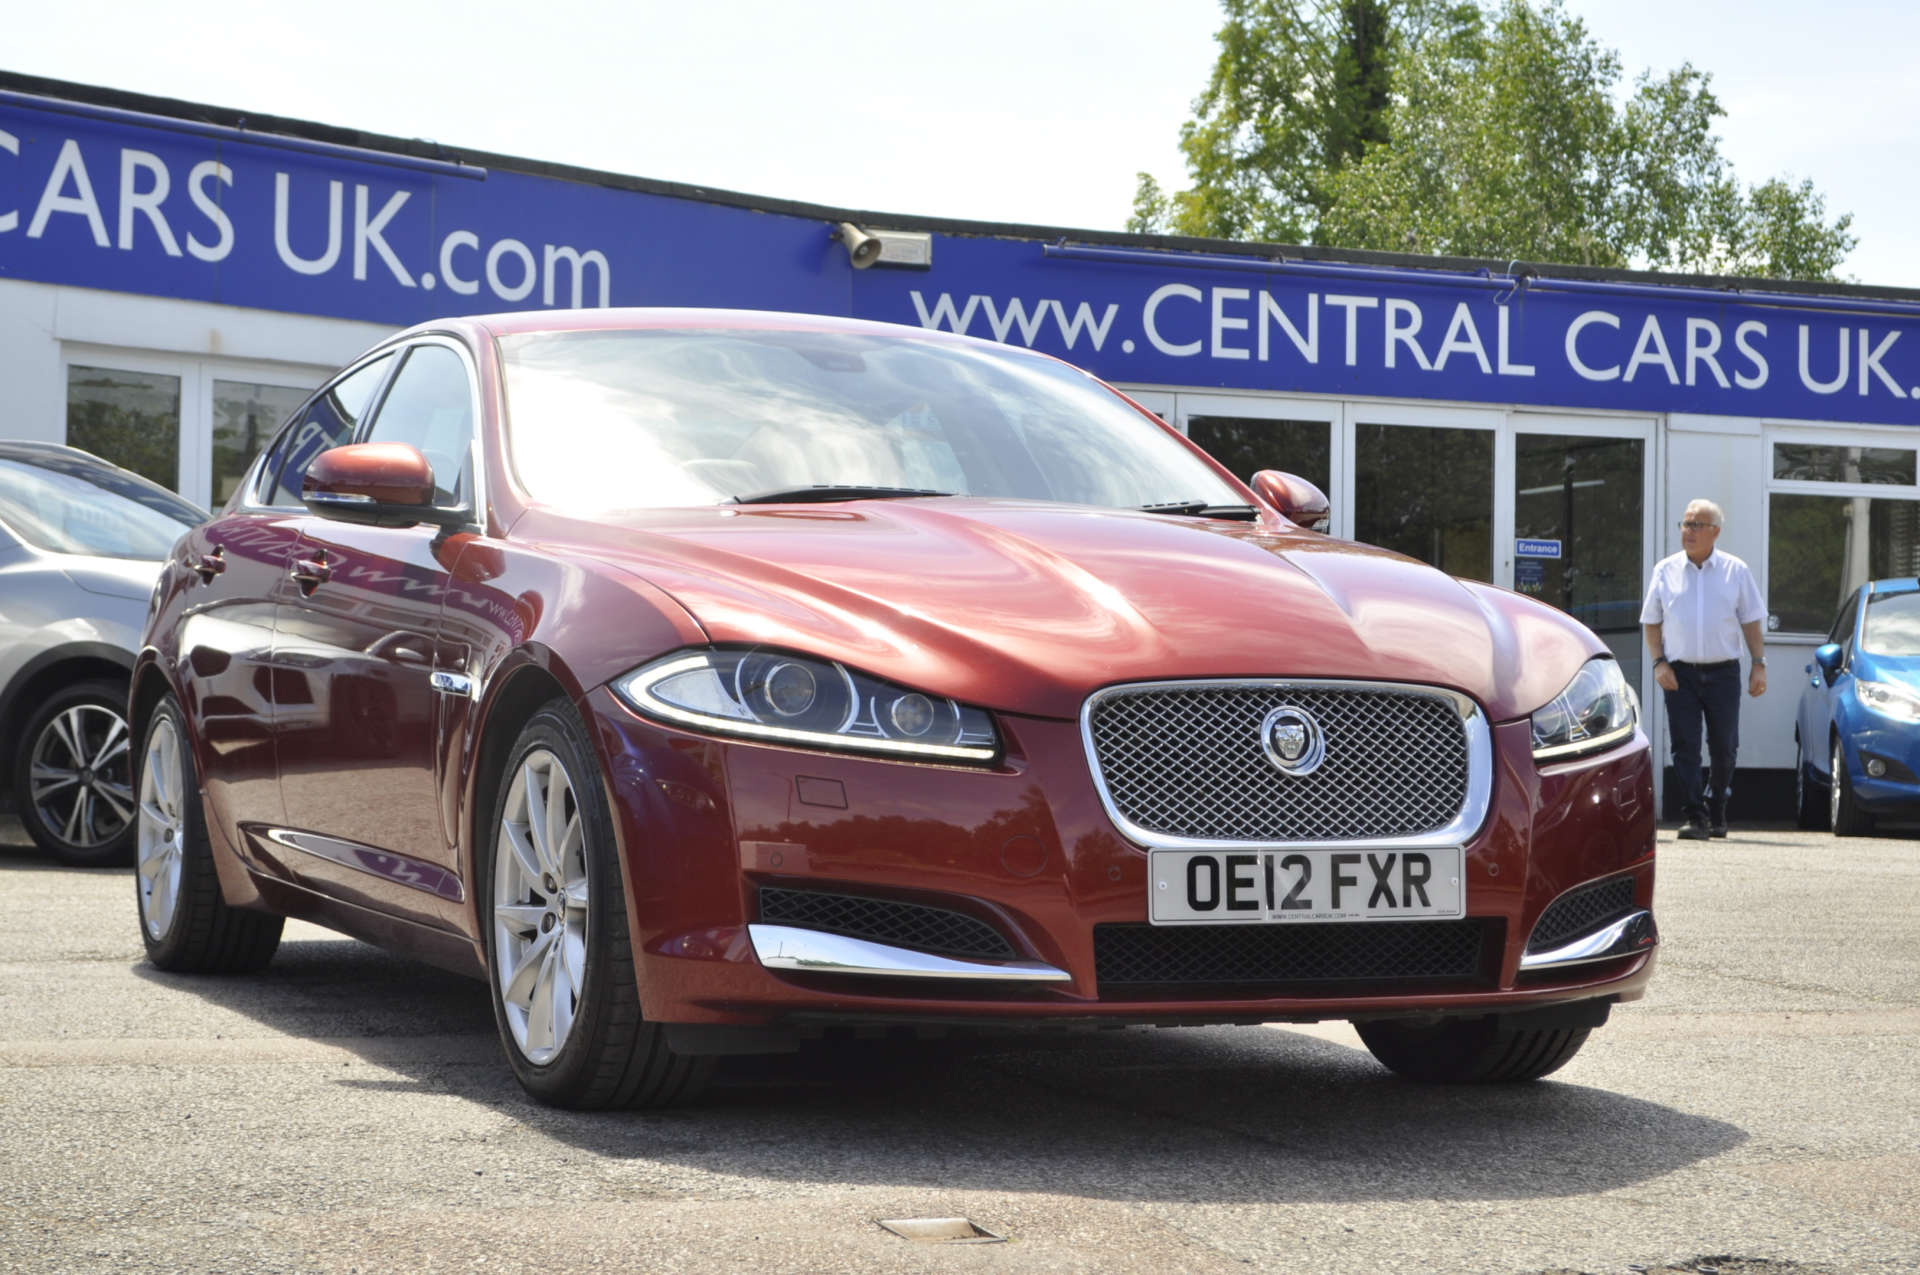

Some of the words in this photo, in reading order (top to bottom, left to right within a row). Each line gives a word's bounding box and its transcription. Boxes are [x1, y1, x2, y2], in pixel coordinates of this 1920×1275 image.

[0, 129, 235, 262] ARS
[273, 172, 610, 309] UK.com
[910, 283, 1535, 376] www.CENTRAL
[1565, 311, 1769, 390] CARS
[1519, 543, 1558, 554] Entrance
[1186, 854, 1313, 912] OE12
[1331, 853, 1432, 909] FXR
